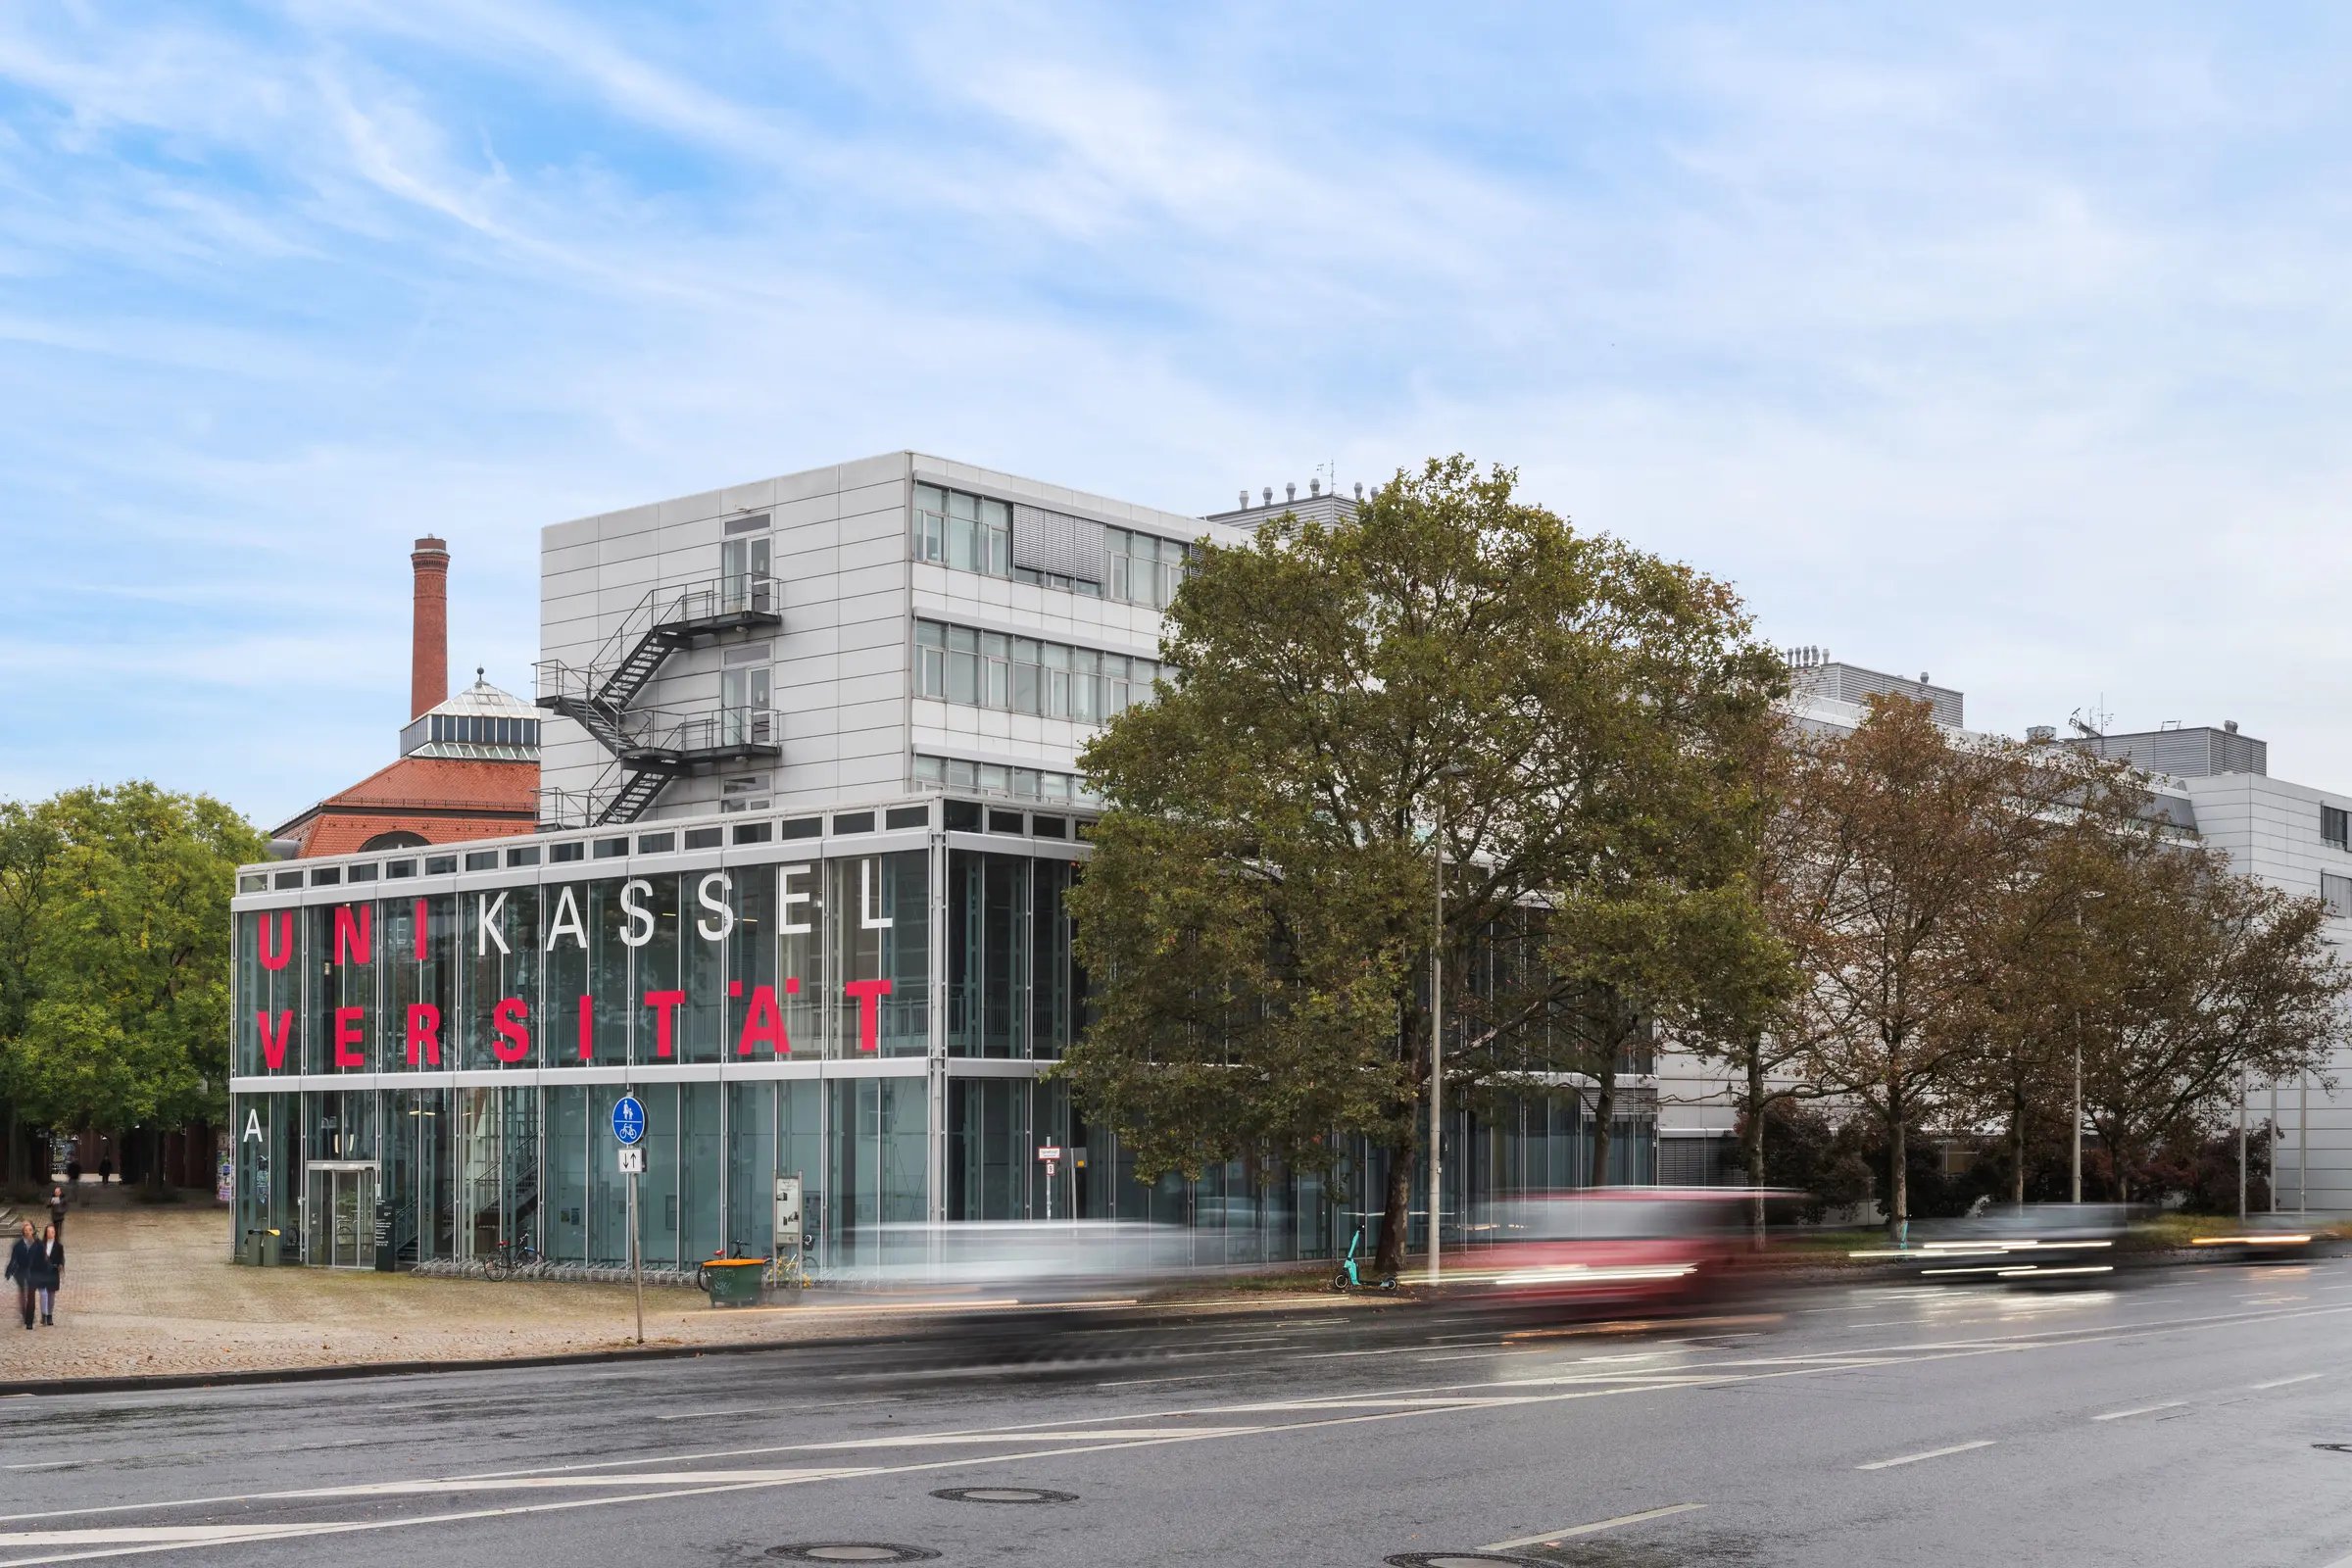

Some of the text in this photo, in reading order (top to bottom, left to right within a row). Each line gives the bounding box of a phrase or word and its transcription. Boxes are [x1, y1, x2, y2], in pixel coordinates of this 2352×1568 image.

[258, 858, 893, 970] UNI KASSEL
[257, 977, 892, 1069] VERSITÄT
[243, 1108, 264, 1143] A
